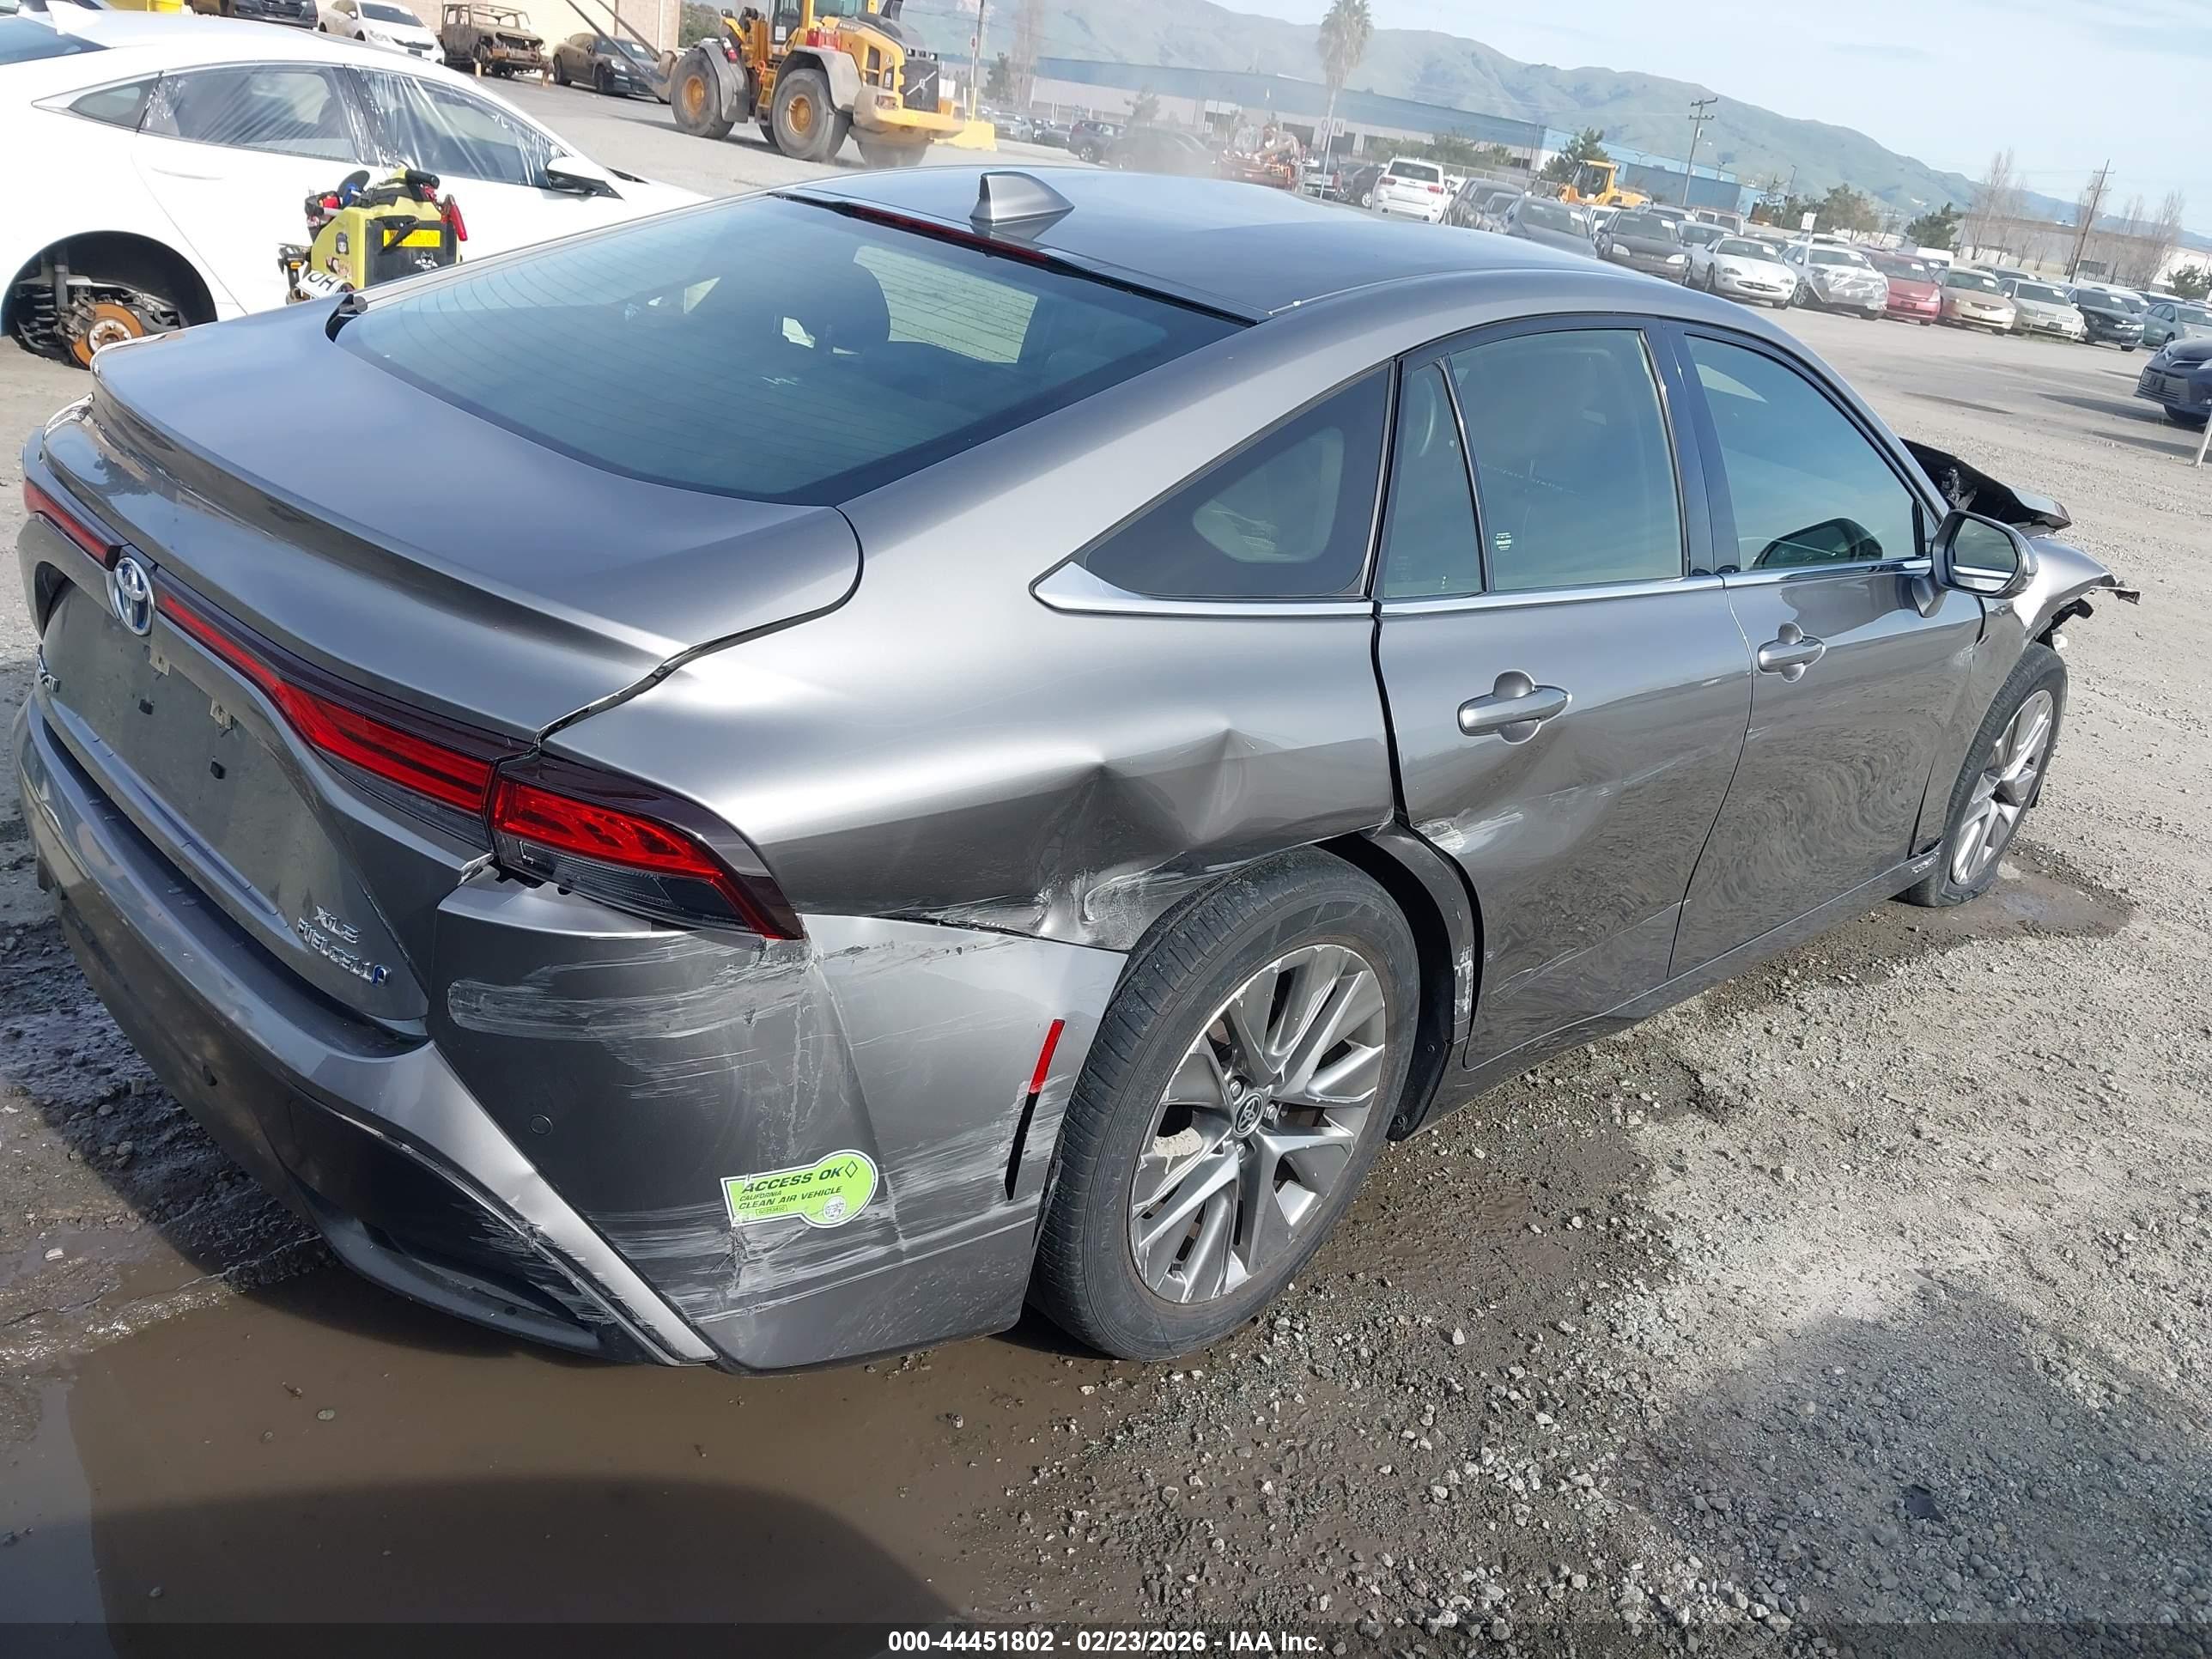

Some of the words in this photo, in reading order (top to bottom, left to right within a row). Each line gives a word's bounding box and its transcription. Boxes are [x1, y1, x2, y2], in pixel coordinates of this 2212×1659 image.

[314, 905, 360, 944] XLE
[742, 1173, 813, 1193] ACCESS
[818, 1166, 844, 1181] OK
[738, 1197, 775, 1210] CLEAN
[778, 1194, 798, 1204] AIR
[800, 1185, 843, 1200] VEHICLE
[739, 1190, 782, 1202] CALIFORNIA
